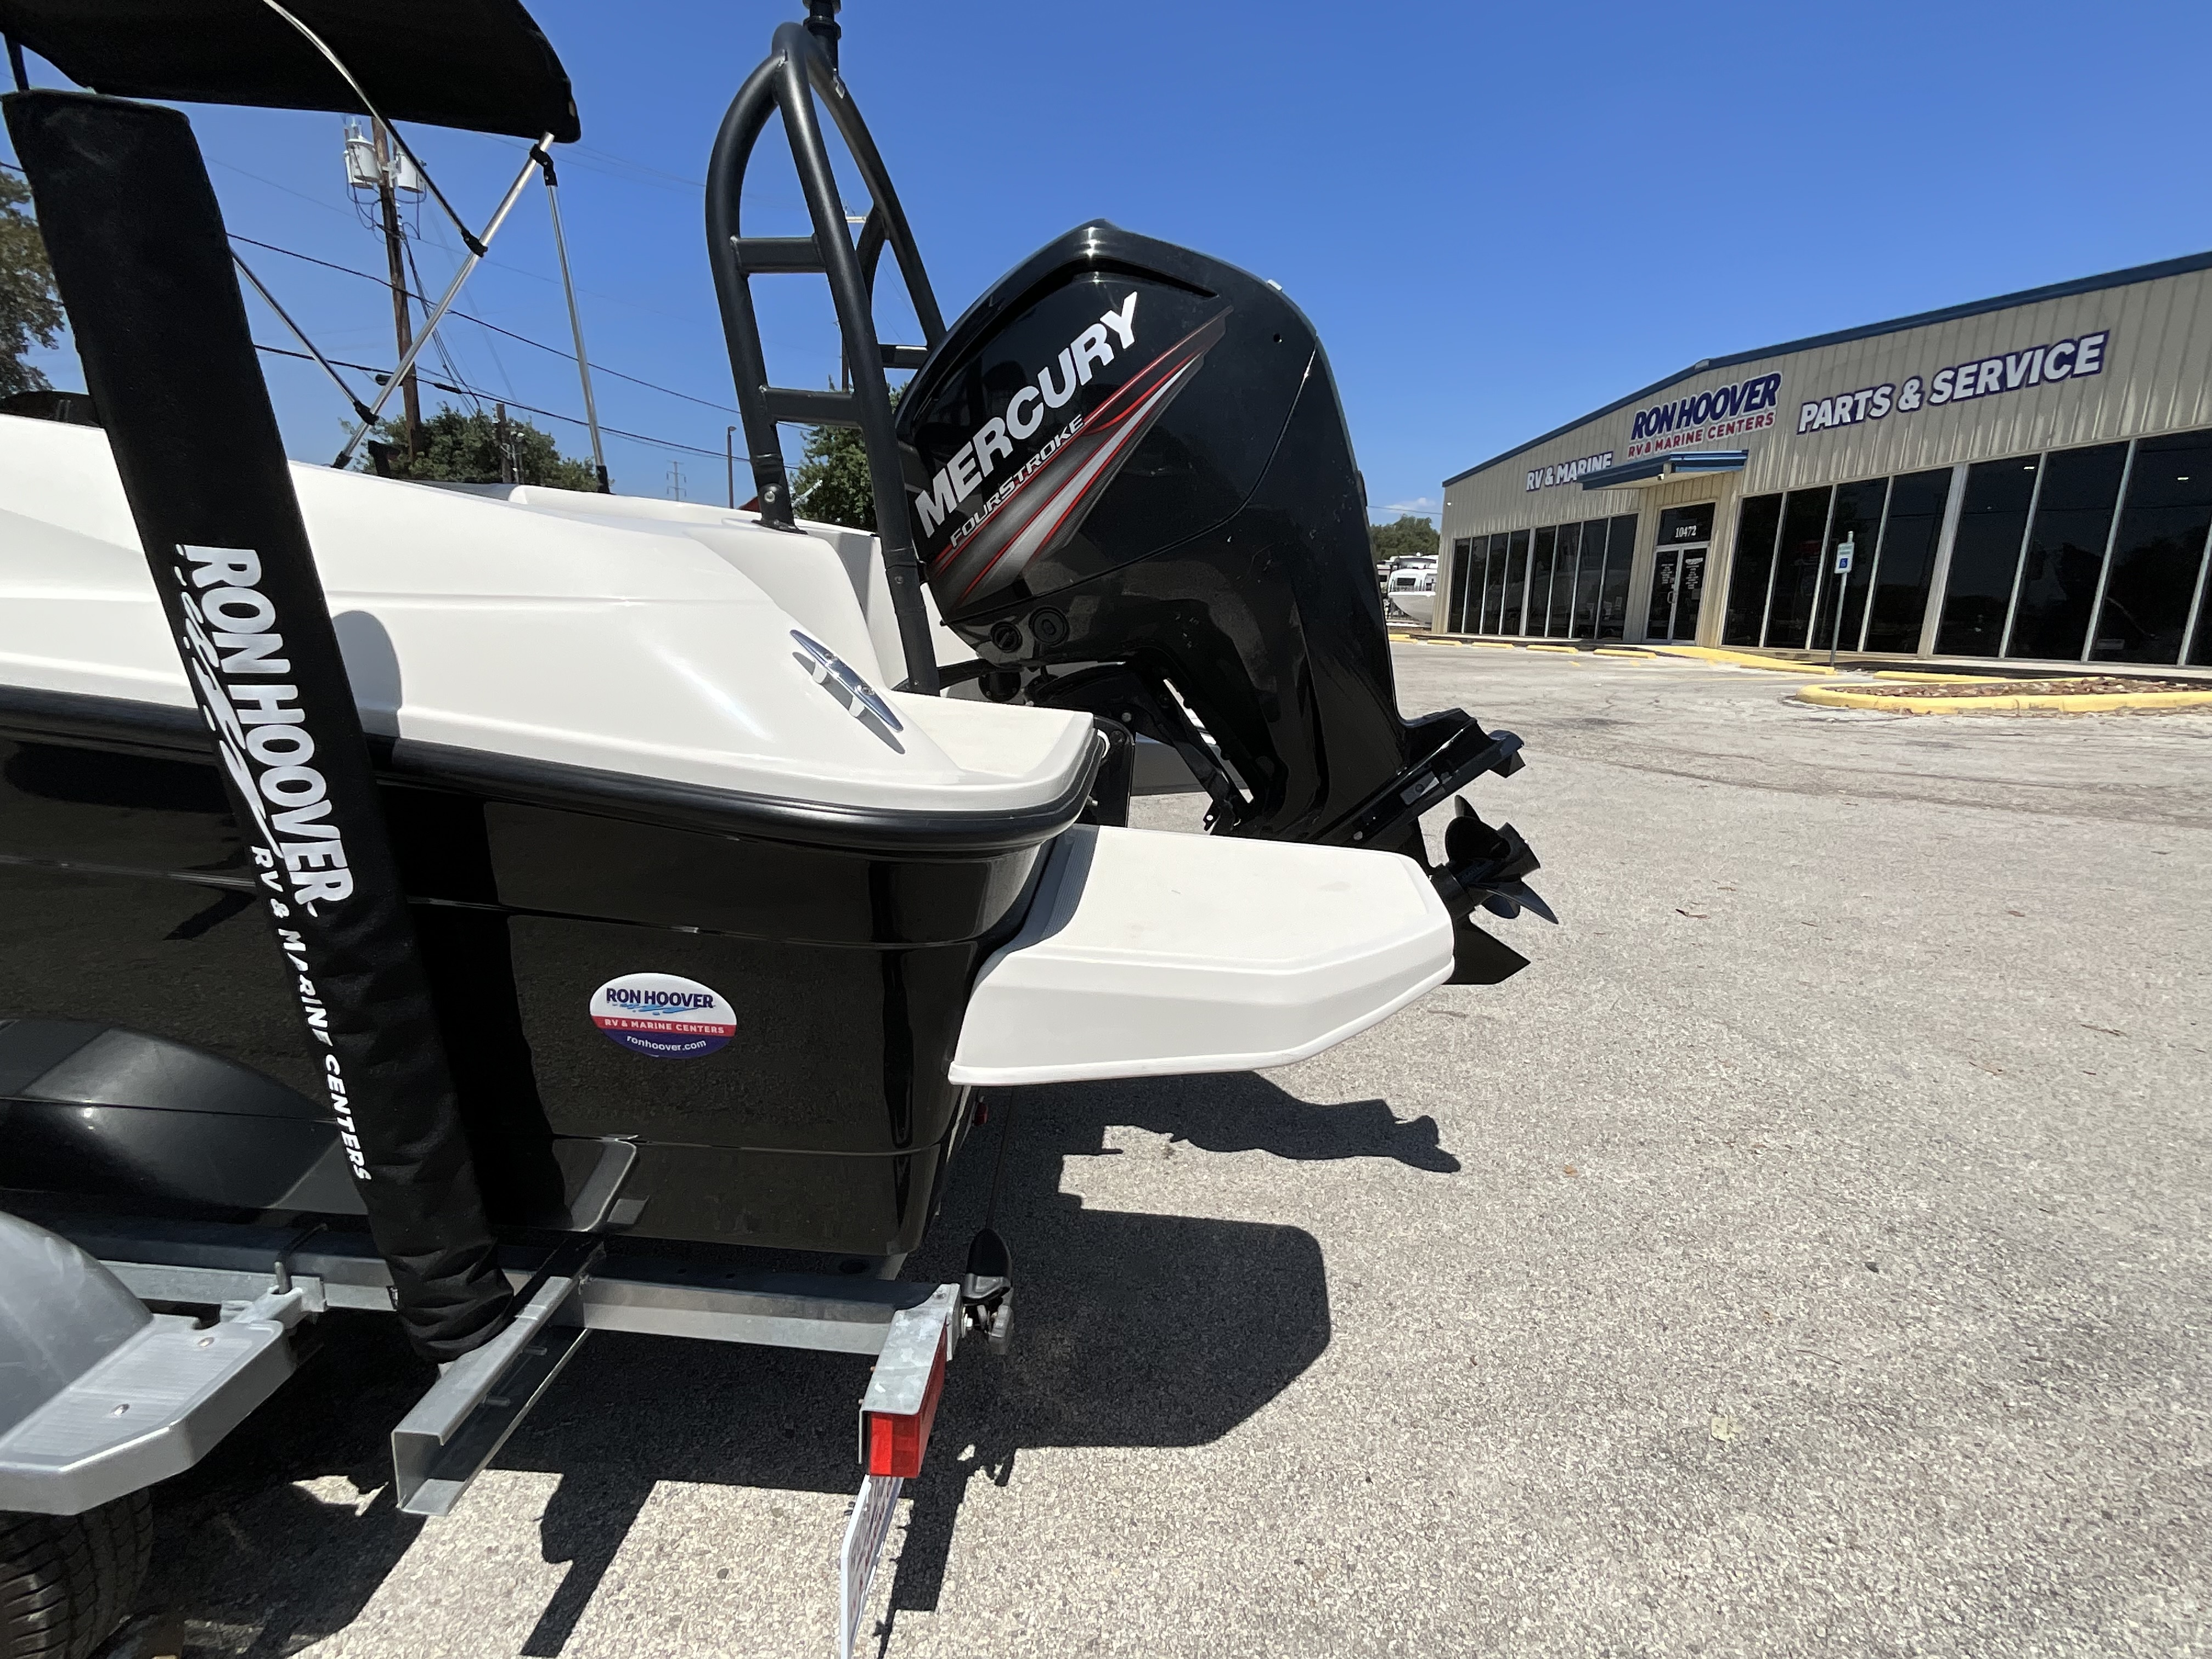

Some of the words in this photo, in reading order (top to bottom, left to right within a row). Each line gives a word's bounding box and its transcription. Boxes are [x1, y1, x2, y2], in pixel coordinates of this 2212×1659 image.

[915, 291, 1138, 538] MERCURY
[1630, 402, 1677, 440] RON
[1676, 373, 1782, 429] HOOVER
[1798, 385, 1893, 432] PARTS
[1898, 377, 1922, 411] &
[1929, 332, 2108, 405] SERVICE
[1628, 444, 1643, 458] RV
[1644, 442, 1651, 453] &
[1655, 429, 1703, 452] MARINE
[1707, 412, 1774, 439] CENTERS
[950, 414, 1086, 549] FOURSTROKE
[1526, 469, 1544, 491] RV
[1545, 466, 1554, 486] &
[1555, 452, 1613, 484] MARINE
[1675, 525, 1697, 538] 10472
[184, 545, 291, 674] RON
[227, 684, 354, 906] HOOVER
[251, 846, 284, 893] RV
[270, 898, 290, 918] &
[325, 1053, 372, 1181] CENTERS
[605, 1018, 618, 1027] RV
[631, 1020, 672, 1030] MARINE
[676, 1024, 725, 1034] CENTERS
[606, 988, 641, 1003] RON
[645, 990, 713, 1008] HOOVER
[627, 1035, 707, 1051] ronhoover.com
